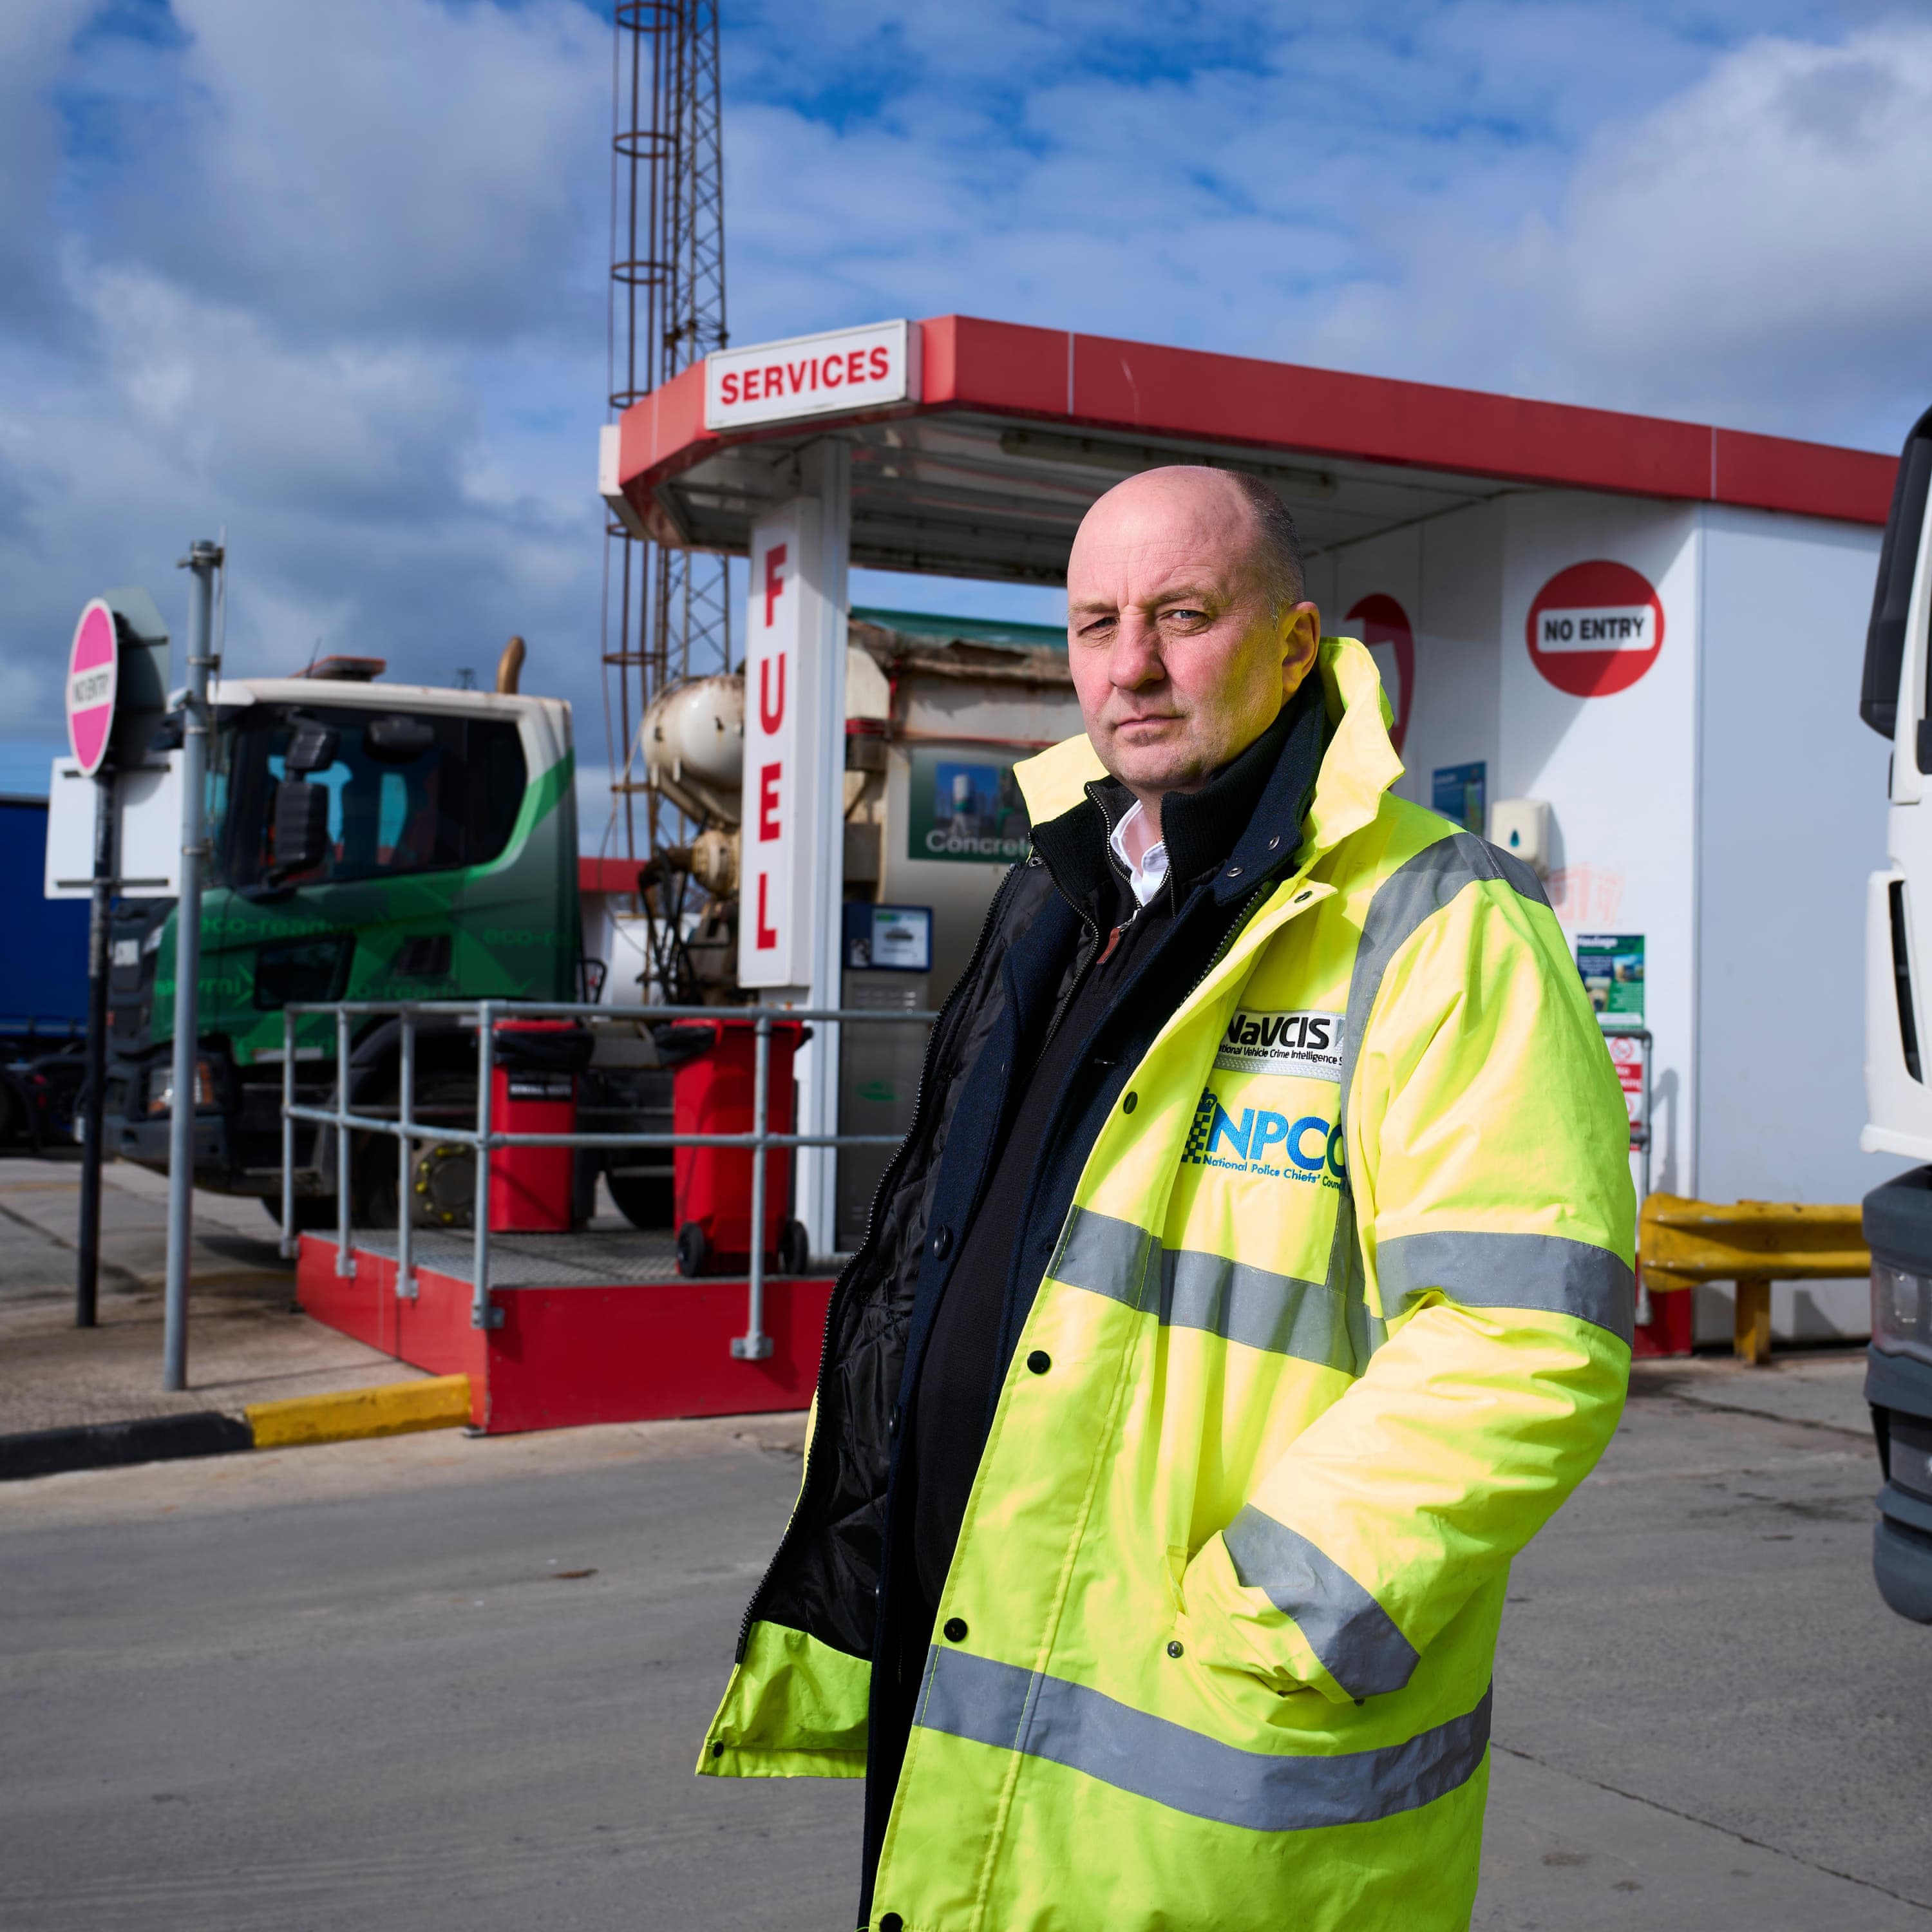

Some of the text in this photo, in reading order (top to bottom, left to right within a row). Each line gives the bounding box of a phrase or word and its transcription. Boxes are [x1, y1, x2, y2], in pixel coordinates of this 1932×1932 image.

[720, 346, 889, 406] SERVICES
[1544, 616, 1644, 641] NO ENTRY
[756, 542, 788, 951] FUEL
[925, 829, 1032, 857] Concret
[1227, 1014, 1331, 1050] NaVCIS
[1218, 1044, 1243, 1056] ational
[1244, 1046, 1268, 1057] Vehicle
[1270, 1049, 1290, 1059] Crime
[1291, 1050, 1338, 1064] Intelligence
[1203, 1153, 1247, 1171] National
[1251, 1163, 1280, 1177] Police
[1283, 1169, 1321, 1184] Chiefs'
